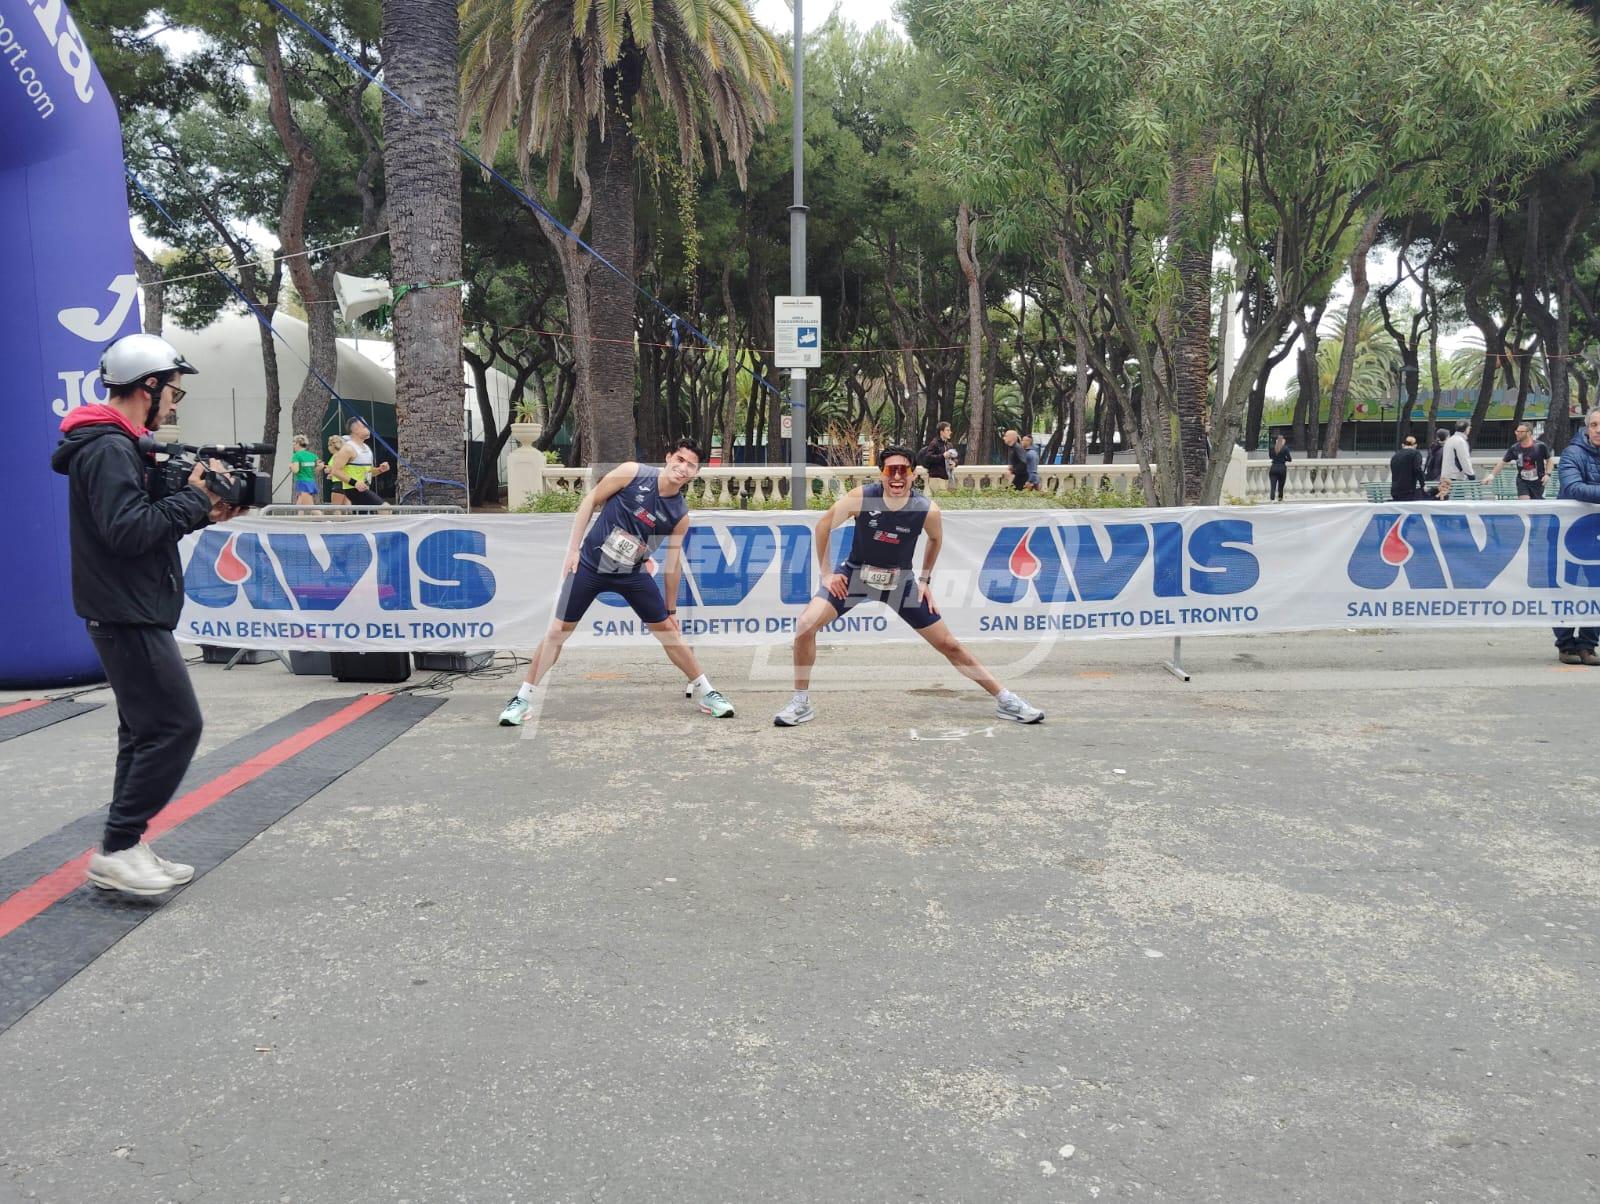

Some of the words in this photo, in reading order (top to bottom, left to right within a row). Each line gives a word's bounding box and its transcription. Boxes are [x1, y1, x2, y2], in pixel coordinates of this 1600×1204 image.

[617, 539, 634, 554] 492
[183, 529, 497, 611] AVIS
[978, 519, 1260, 604] AVIS
[870, 573, 887, 582] 493
[1347, 601, 1387, 616] SAN
[1392, 600, 1507, 616] BENEDETTO
[1512, 600, 1548, 616] DEL
[1552, 600, 1600, 615] TRON
[593, 620, 634, 637] SAN
[640, 617, 760, 636] BEDETTO
[979, 615, 1018, 631] SAN
[1024, 610, 1135, 631] BENEDETTO
[1140, 609, 1176, 626] DEL
[1179, 606, 1259, 624] TRONTO
[190, 620, 231, 637] SAN
[236, 621, 360, 639] BENEDETTO
[366, 622, 405, 639] DEL
[409, 621, 494, 639] TRONTO
